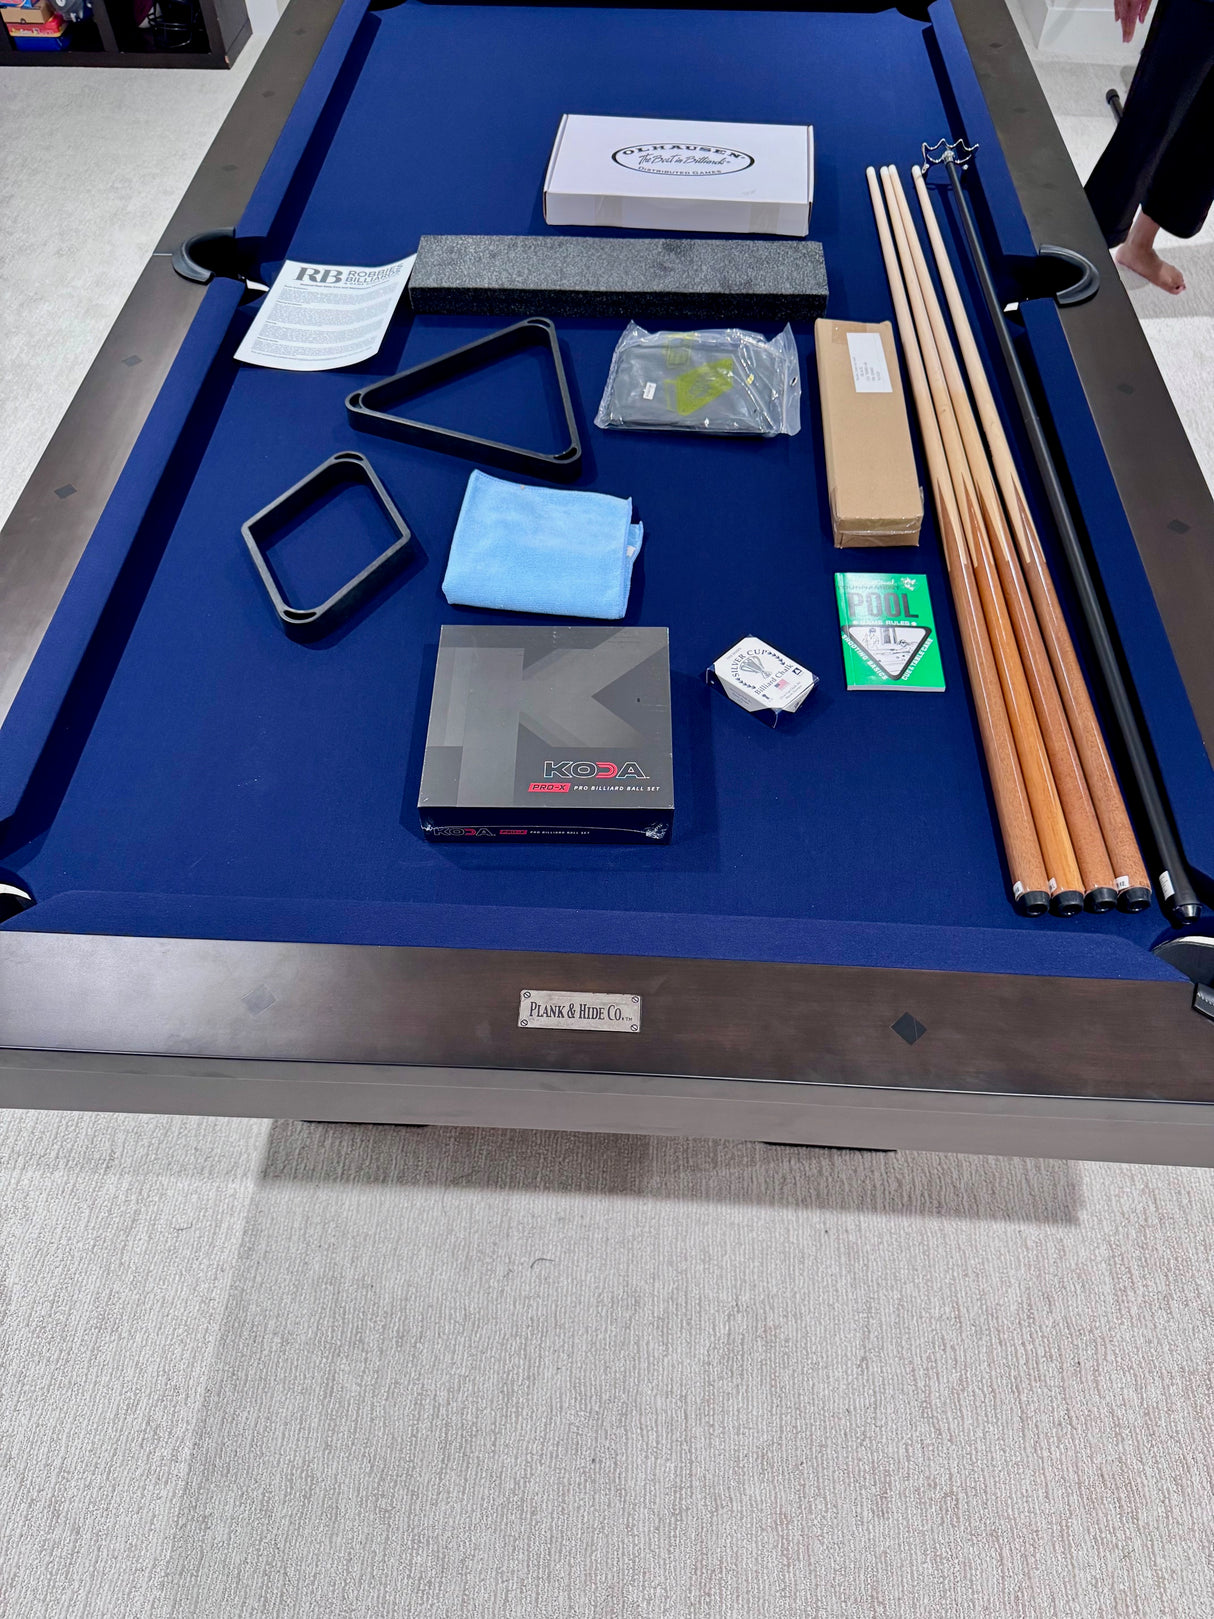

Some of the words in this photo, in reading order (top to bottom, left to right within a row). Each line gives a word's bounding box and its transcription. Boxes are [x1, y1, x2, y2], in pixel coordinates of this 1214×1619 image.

[622, 145, 742, 159] OLHAUSEN
[638, 153, 652, 165] The
[651, 154, 676, 164] Best
[295, 267, 343, 284] RB
[847, 592, 919, 618] POOL
[731, 653, 746, 678] SILVER
[866, 660, 888, 680] BASICS
[754, 678, 776, 695] Billiard
[774, 664, 793, 679] Chalk
[543, 761, 647, 779] KODA
[529, 1002, 565, 1018] PLANK
[567, 1003, 576, 1019] &
[579, 1004, 605, 1020] HIDE
